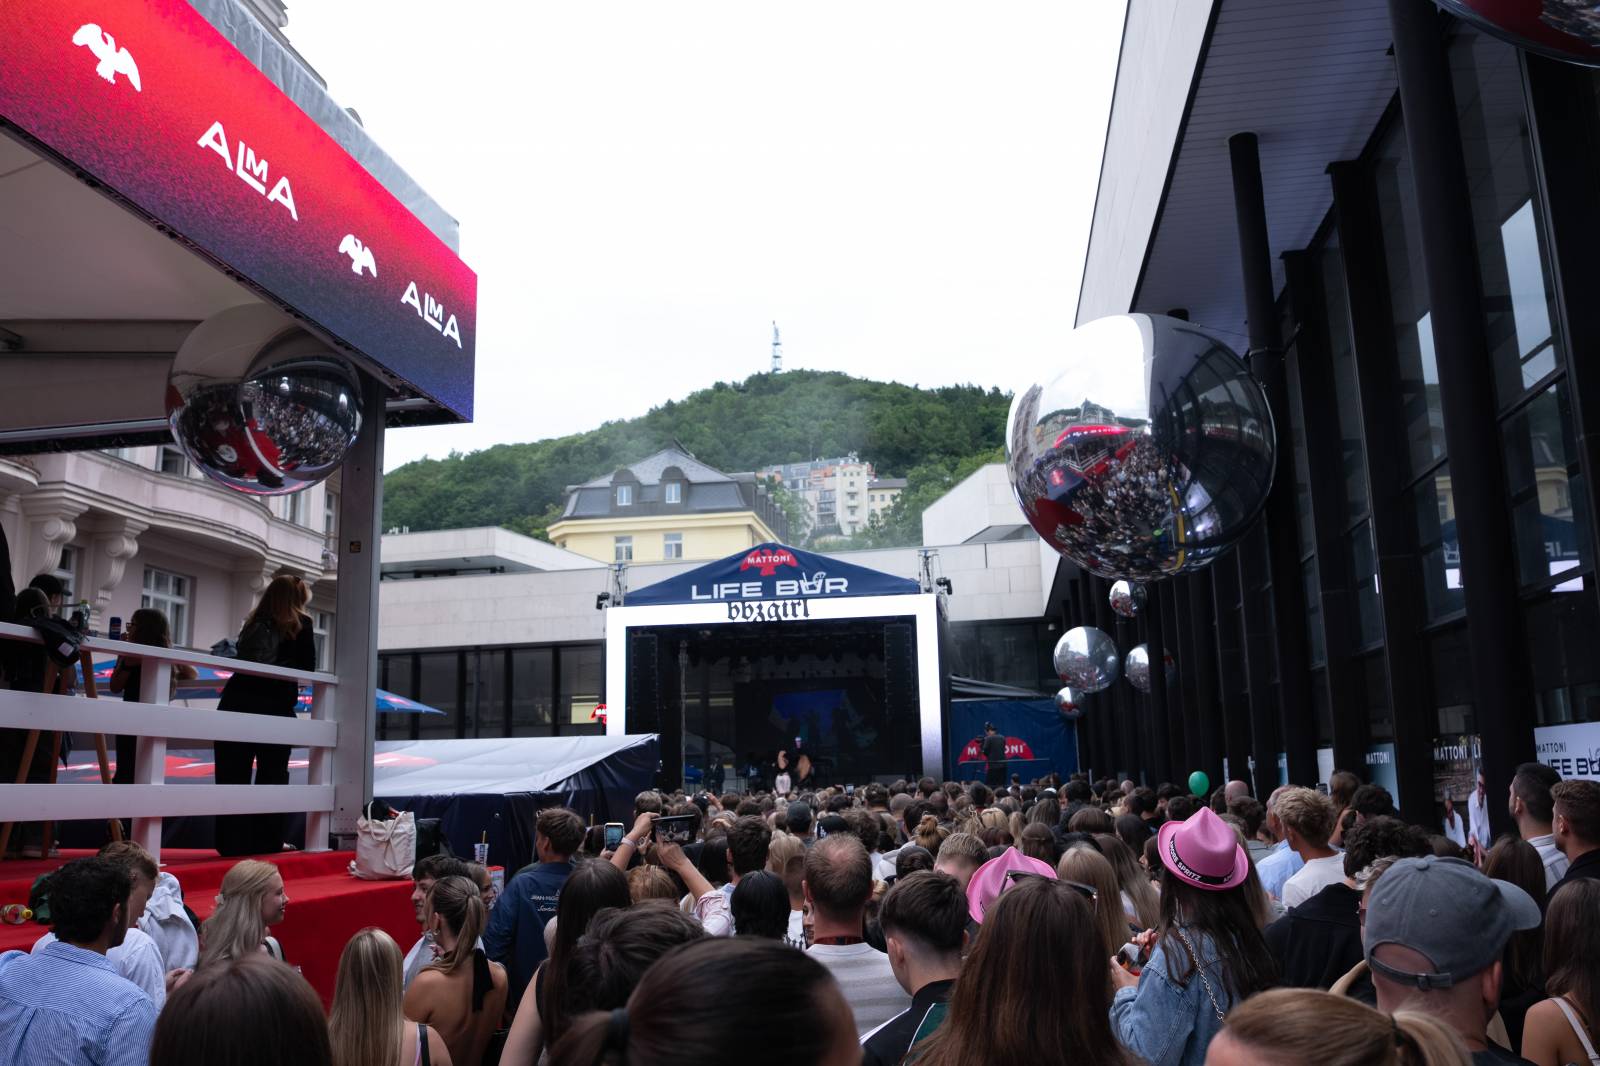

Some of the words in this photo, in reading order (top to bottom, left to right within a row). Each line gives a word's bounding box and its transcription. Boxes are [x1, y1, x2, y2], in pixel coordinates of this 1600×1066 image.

[196, 120, 299, 222] ALMA
[400, 280, 463, 349] ALMA
[747, 555, 790, 564] MATTONI
[691, 581, 763, 600] LIFE
[967, 744, 1025, 756] MONI
[1433, 744, 1468, 761] MATTONI
[1536, 742, 1567, 753] MATTONI
[1365, 752, 1390, 765] MATTONI
[1177, 861, 1202, 881] SPRITZ
